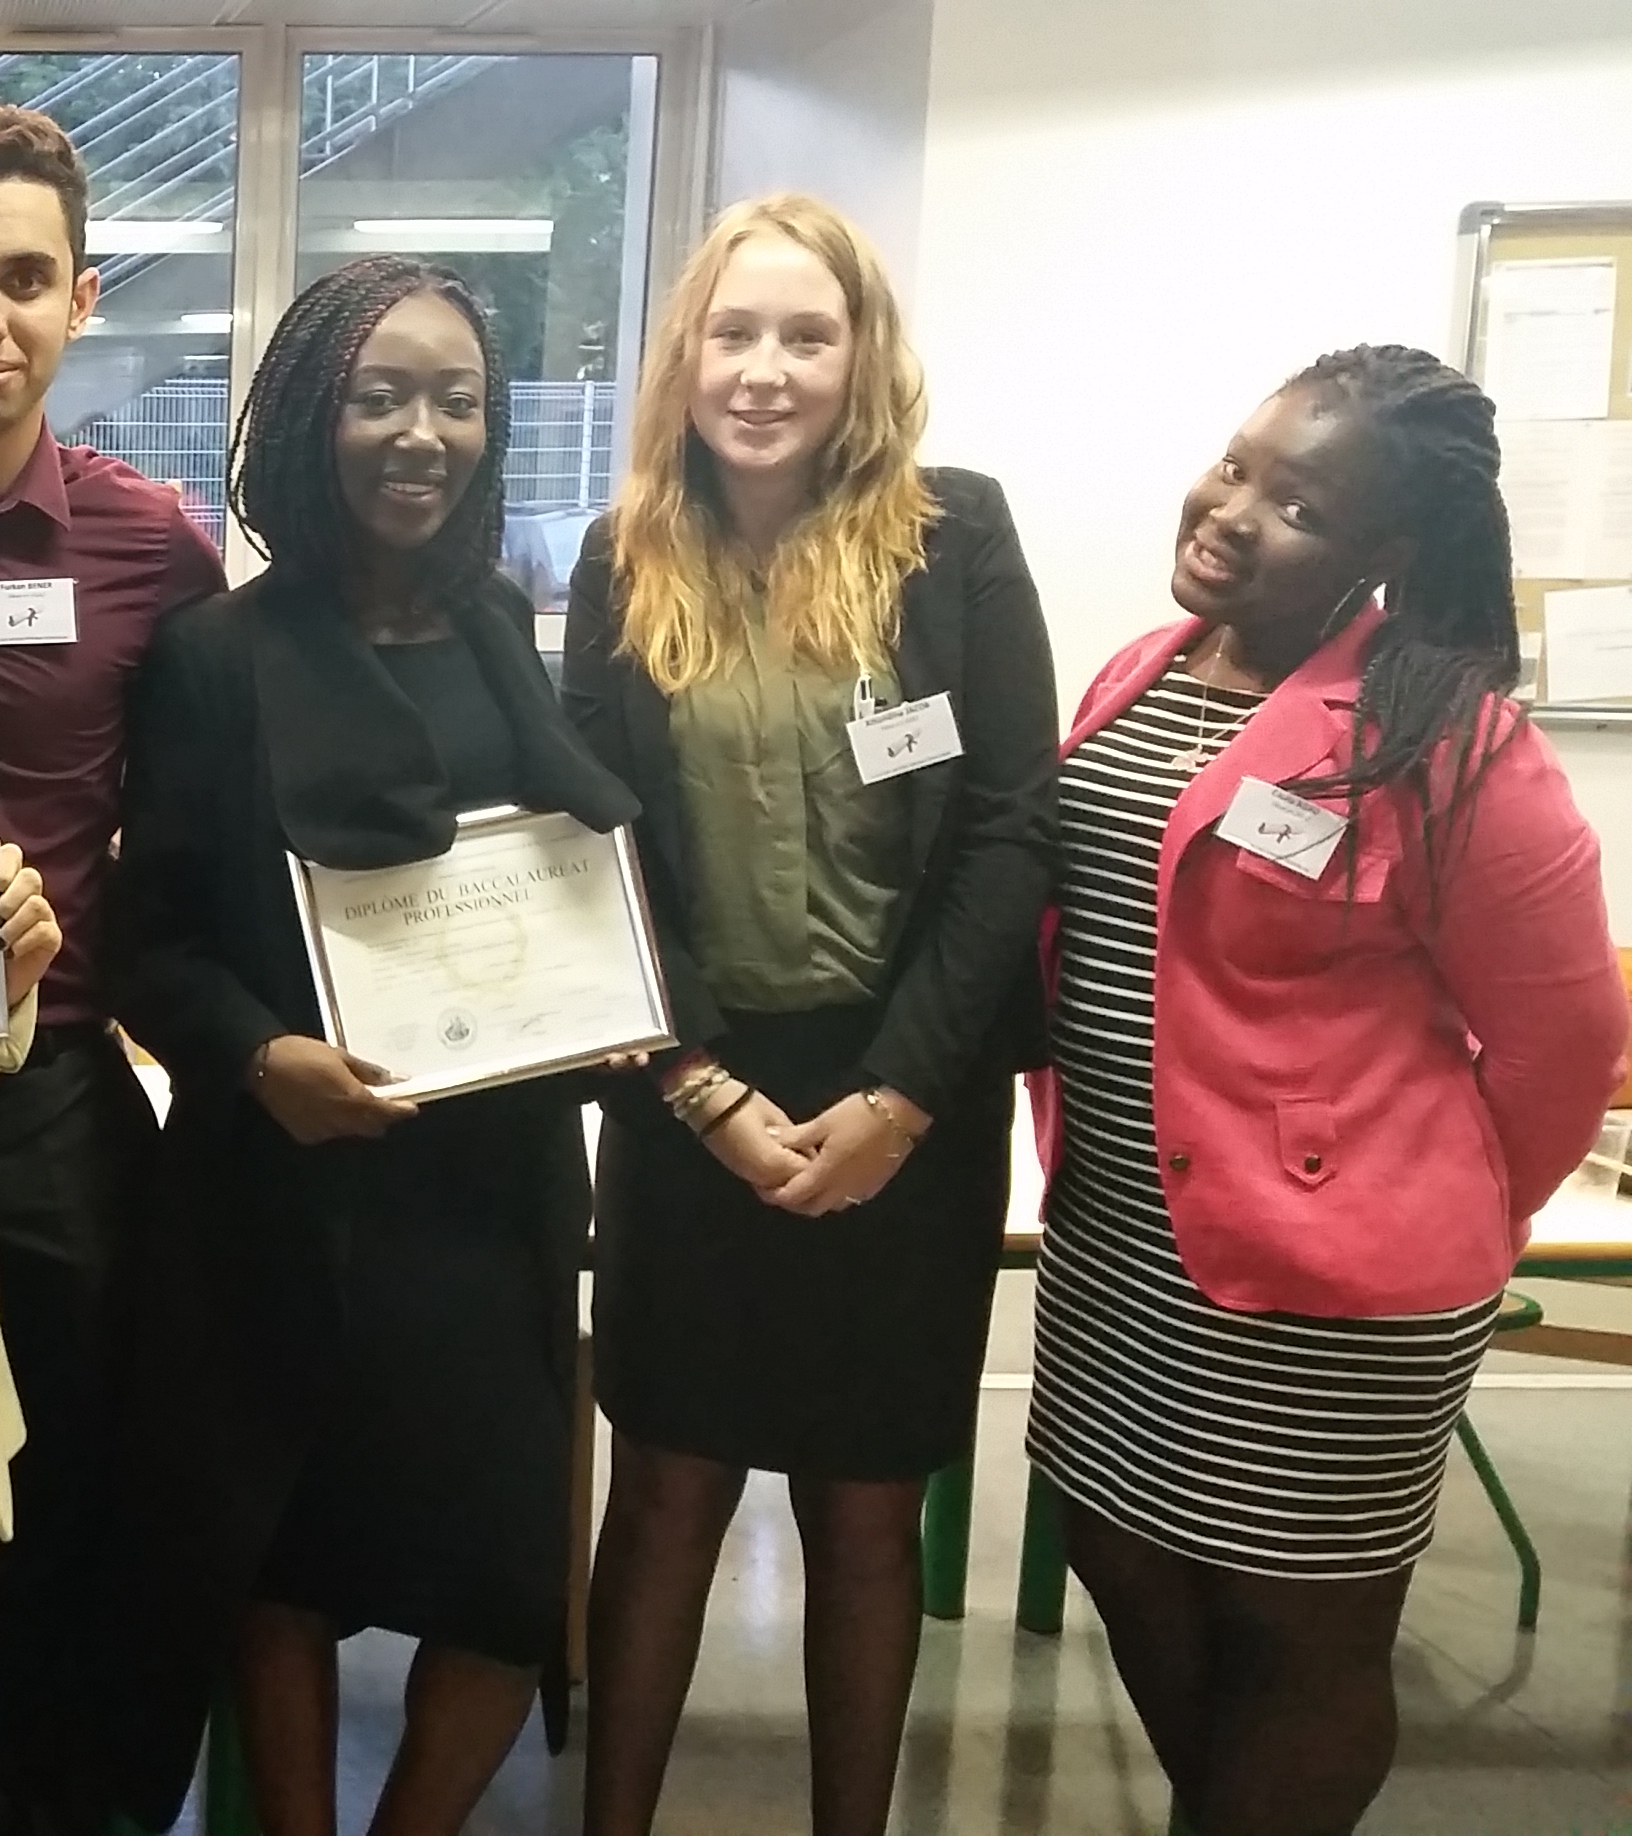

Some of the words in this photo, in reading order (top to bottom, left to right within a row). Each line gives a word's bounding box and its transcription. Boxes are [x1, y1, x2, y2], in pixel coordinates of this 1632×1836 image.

[344, 892, 418, 921] DIPLÔME
[427, 885, 448, 904] DU
[404, 887, 532, 926] PROFESSIONNEL
